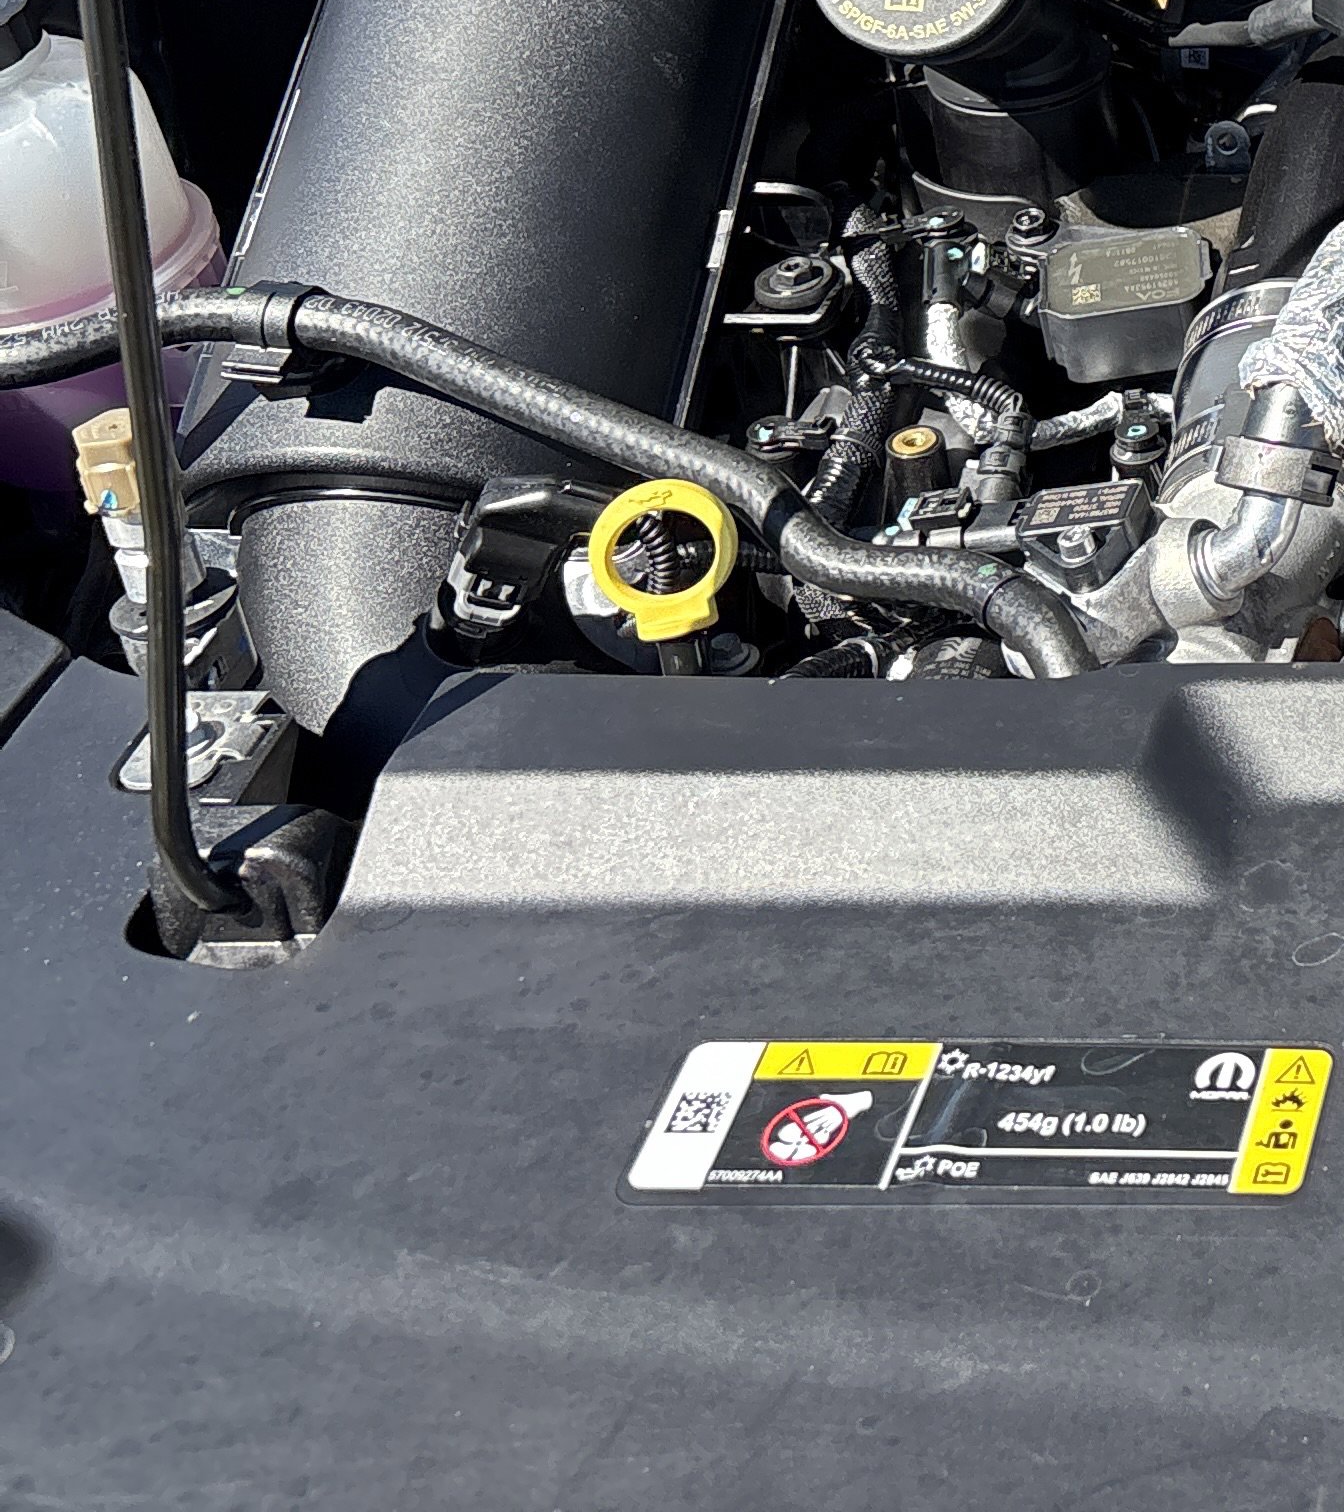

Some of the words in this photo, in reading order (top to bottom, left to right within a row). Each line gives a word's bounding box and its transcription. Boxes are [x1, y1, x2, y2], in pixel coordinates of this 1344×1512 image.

[961, 1061, 1056, 1084] R-1234yf
[998, 1112, 1058, 1138] 454g
[1061, 1112, 1110, 1137] (1.0
[1111, 1113, 1147, 1138] lb)
[937, 1160, 979, 1180] POE
[1088, 1172, 1119, 1185] SAE
